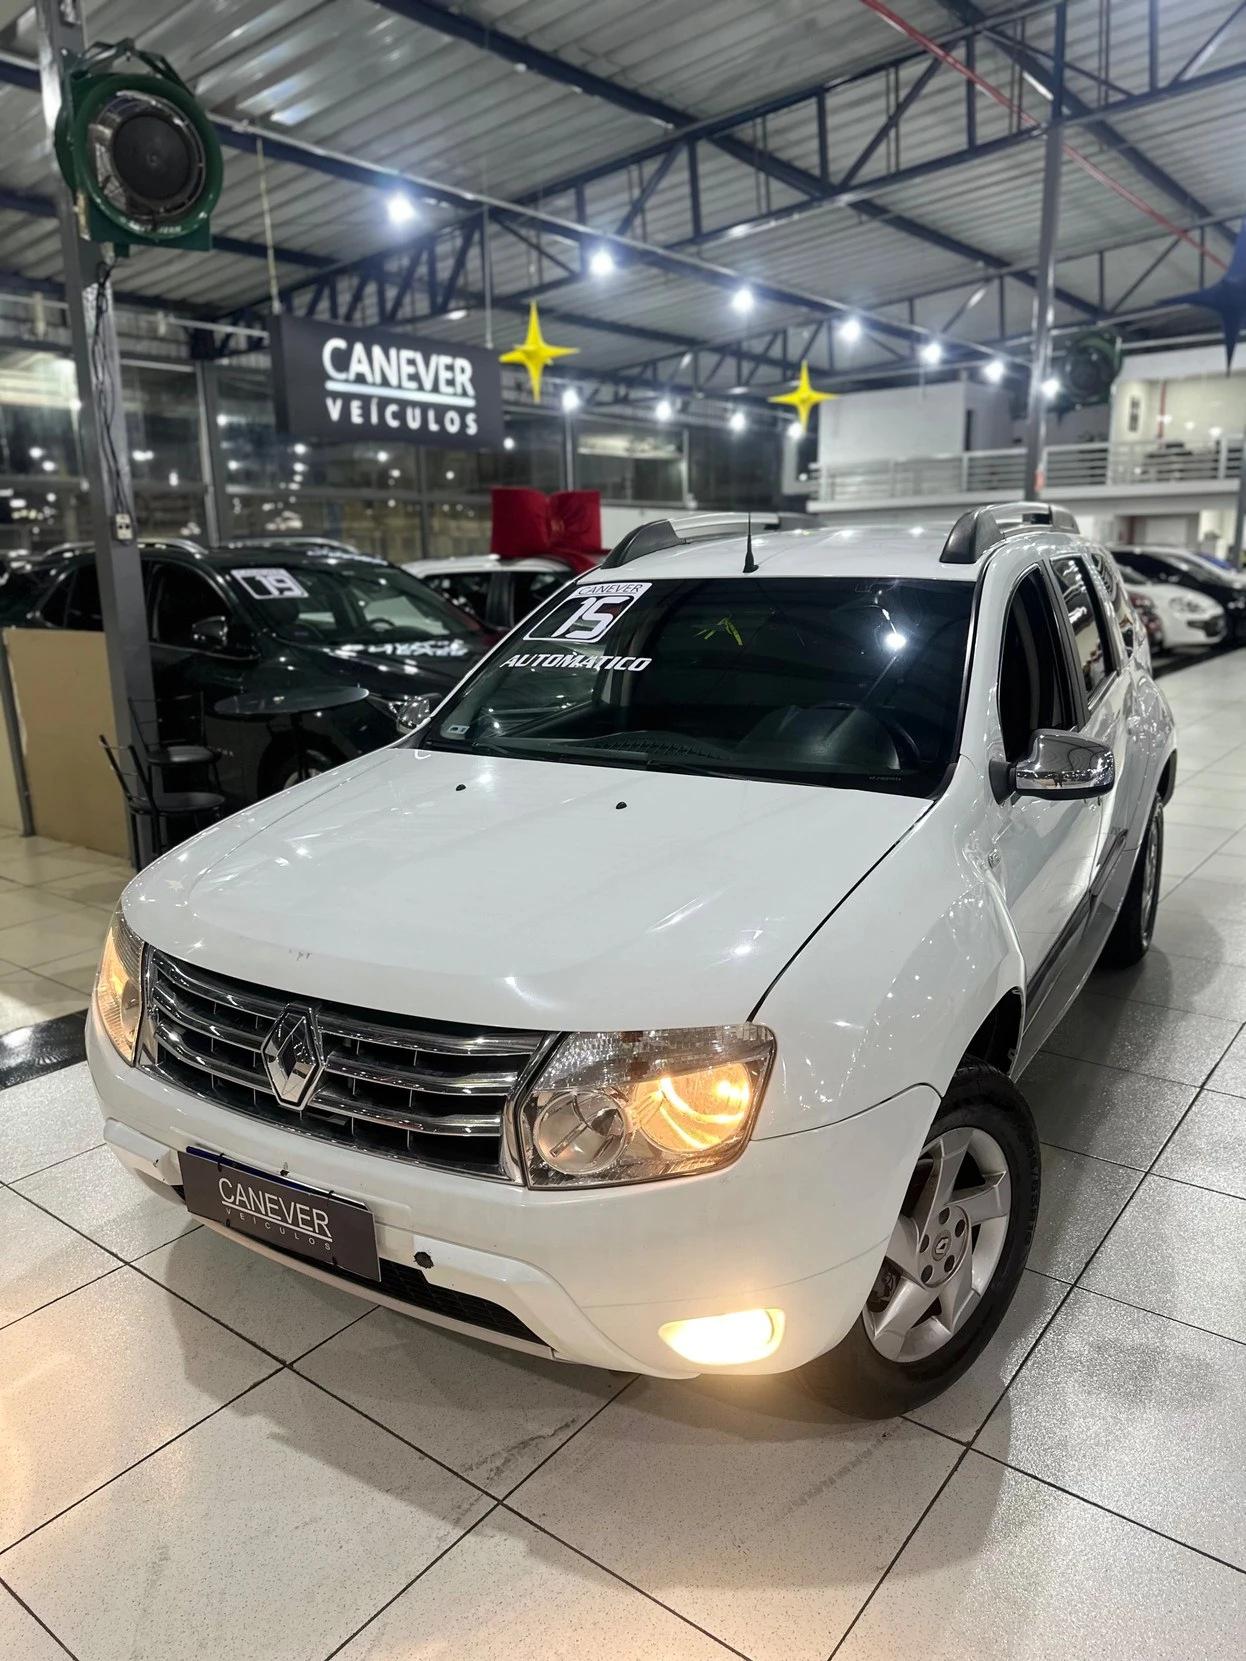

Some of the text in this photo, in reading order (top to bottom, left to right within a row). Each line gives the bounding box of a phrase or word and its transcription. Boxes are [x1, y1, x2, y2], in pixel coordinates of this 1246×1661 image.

[322, 337, 475, 397] CANEVER
[325, 396, 478, 436] VEÍCULOS
[578, 583, 644, 596] CANEVER
[551, 596, 632, 640] 15
[219, 1177, 333, 1238] CANEVER
